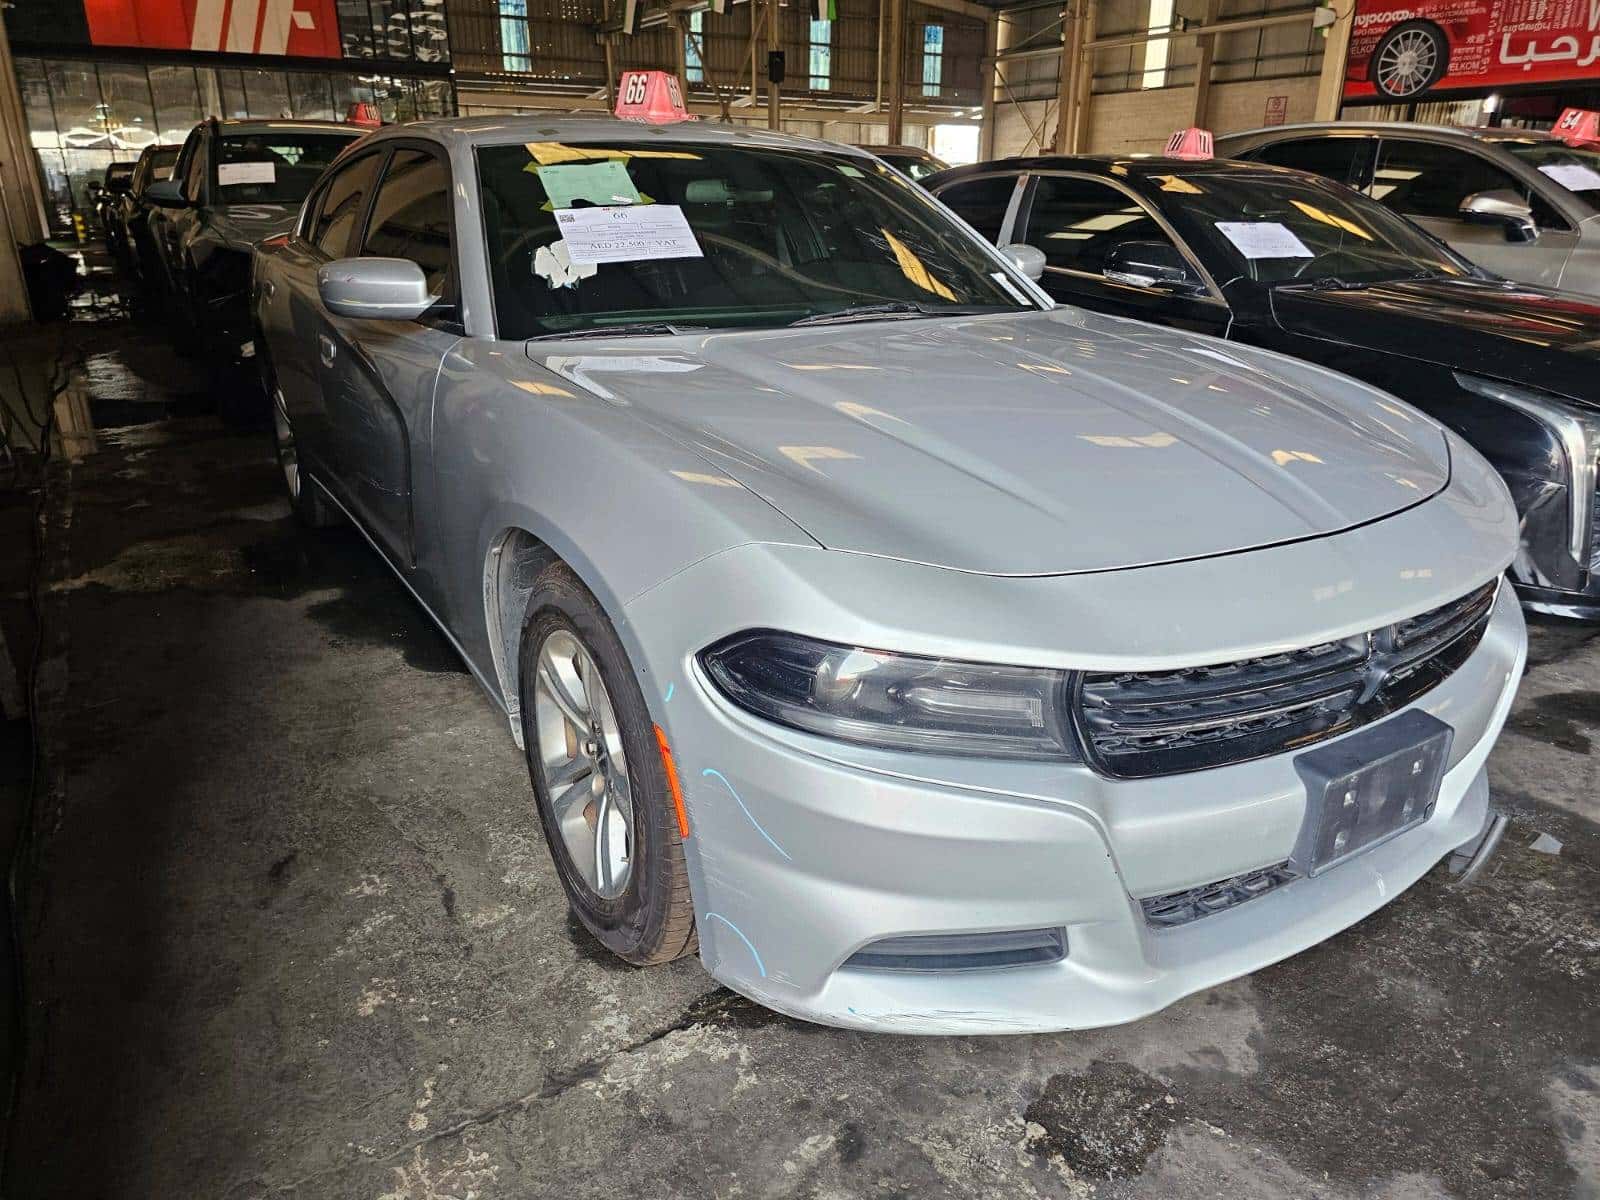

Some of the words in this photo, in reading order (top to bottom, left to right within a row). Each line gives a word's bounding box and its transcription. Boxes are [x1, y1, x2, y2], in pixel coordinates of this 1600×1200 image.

[1499, 33, 1600, 71] رحبا
[625, 74, 648, 105] 66
[1560, 111, 1583, 130] 54
[590, 241, 612, 250] AED
[655, 239, 680, 247] VAT
